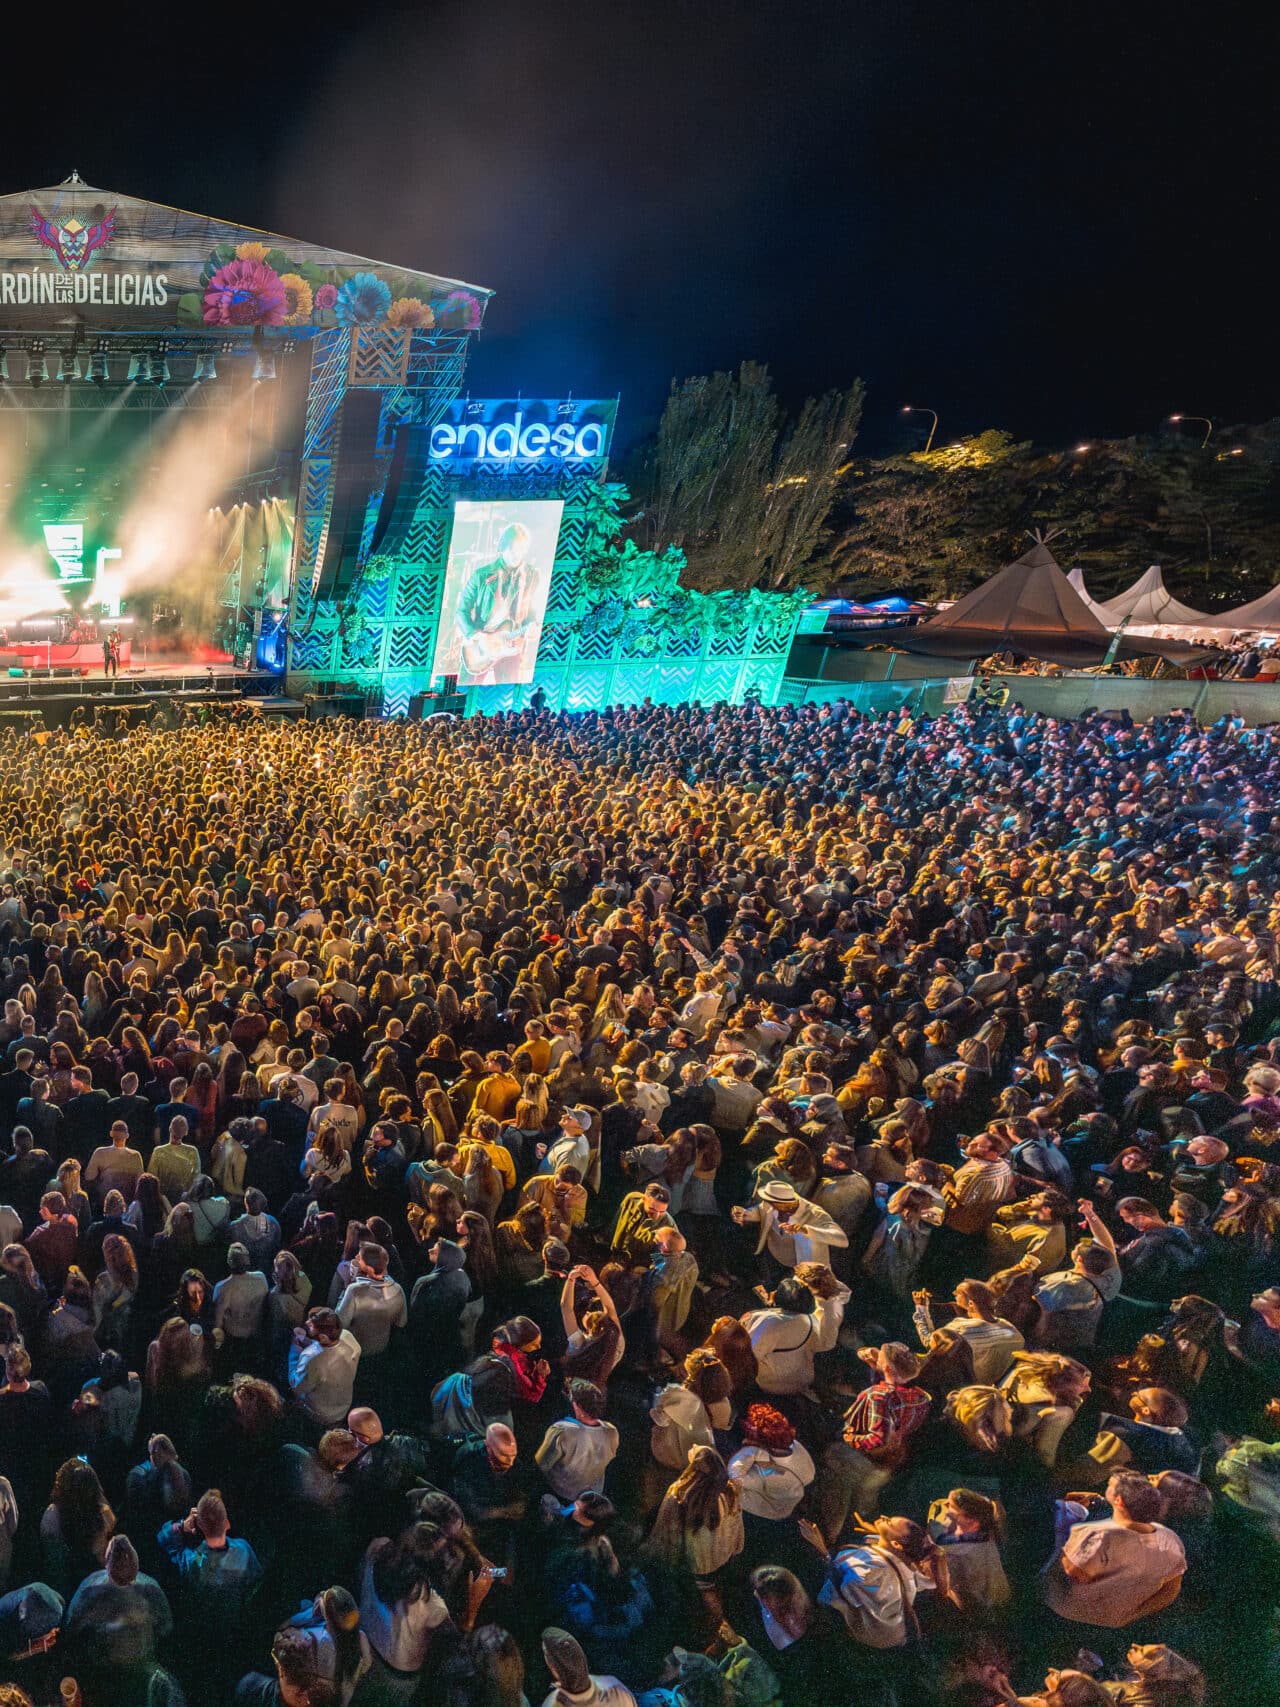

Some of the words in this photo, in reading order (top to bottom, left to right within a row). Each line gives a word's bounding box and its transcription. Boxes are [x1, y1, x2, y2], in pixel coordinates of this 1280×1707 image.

[55, 274, 73, 285] DE
[74, 274, 168, 305] DELICIAS
[56, 290, 74, 303] LAS
[429, 411, 608, 459] endesa
